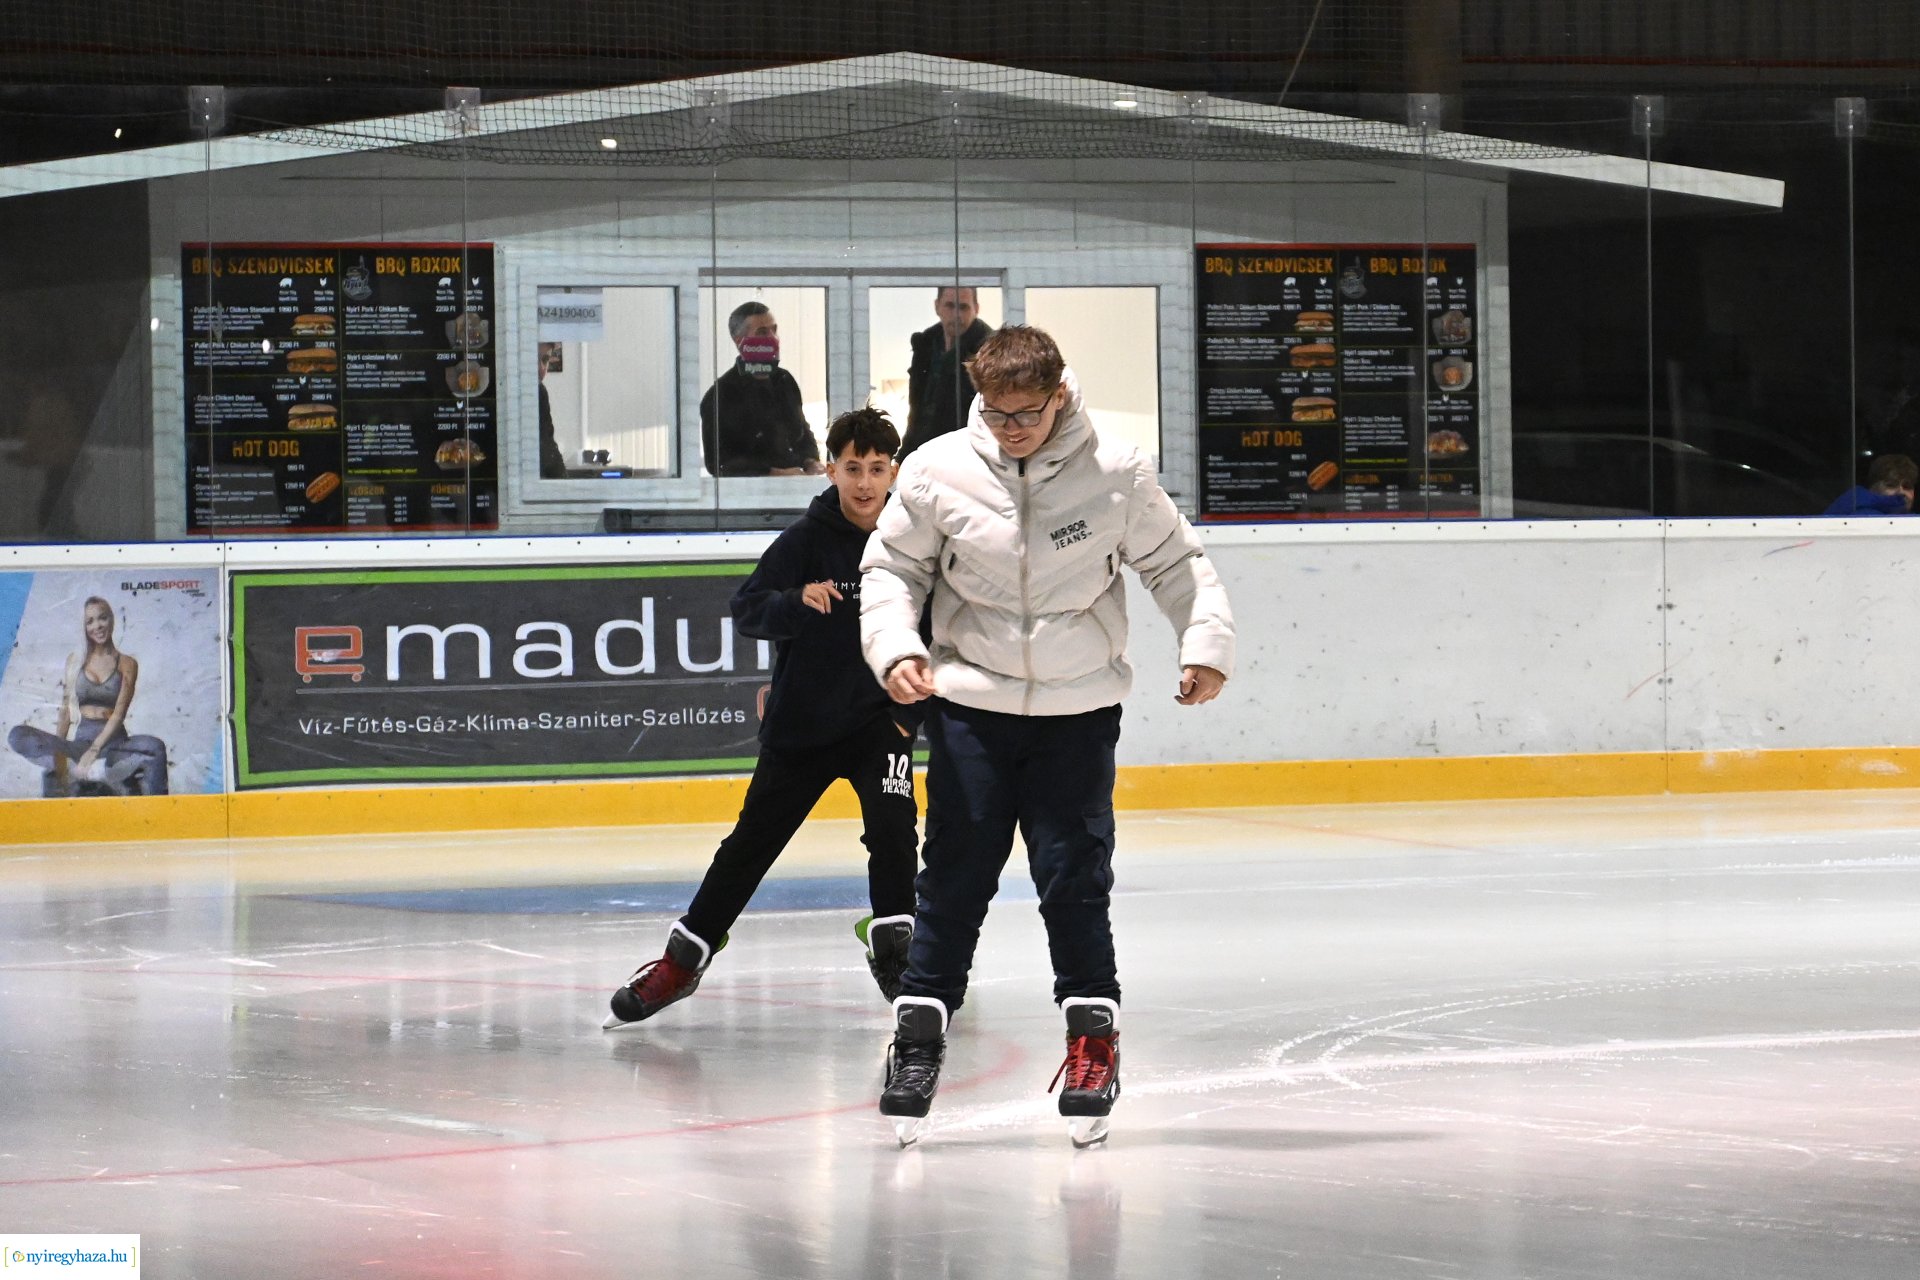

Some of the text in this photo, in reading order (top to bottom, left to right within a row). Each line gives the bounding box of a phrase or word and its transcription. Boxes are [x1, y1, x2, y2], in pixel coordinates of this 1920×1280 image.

[228, 257, 335, 275] SZENDVICSEK
[376, 256, 462, 277] BBQ BOXOK
[1205, 257, 1333, 277] BBQ SZENDVICSEK
[1370, 257, 1397, 275] BBQ
[1242, 431, 1302, 447] HOT DOG
[233, 440, 300, 457] HOT DOG
[121, 580, 201, 590] BLADESPORT
[887, 753, 909, 780] 10
